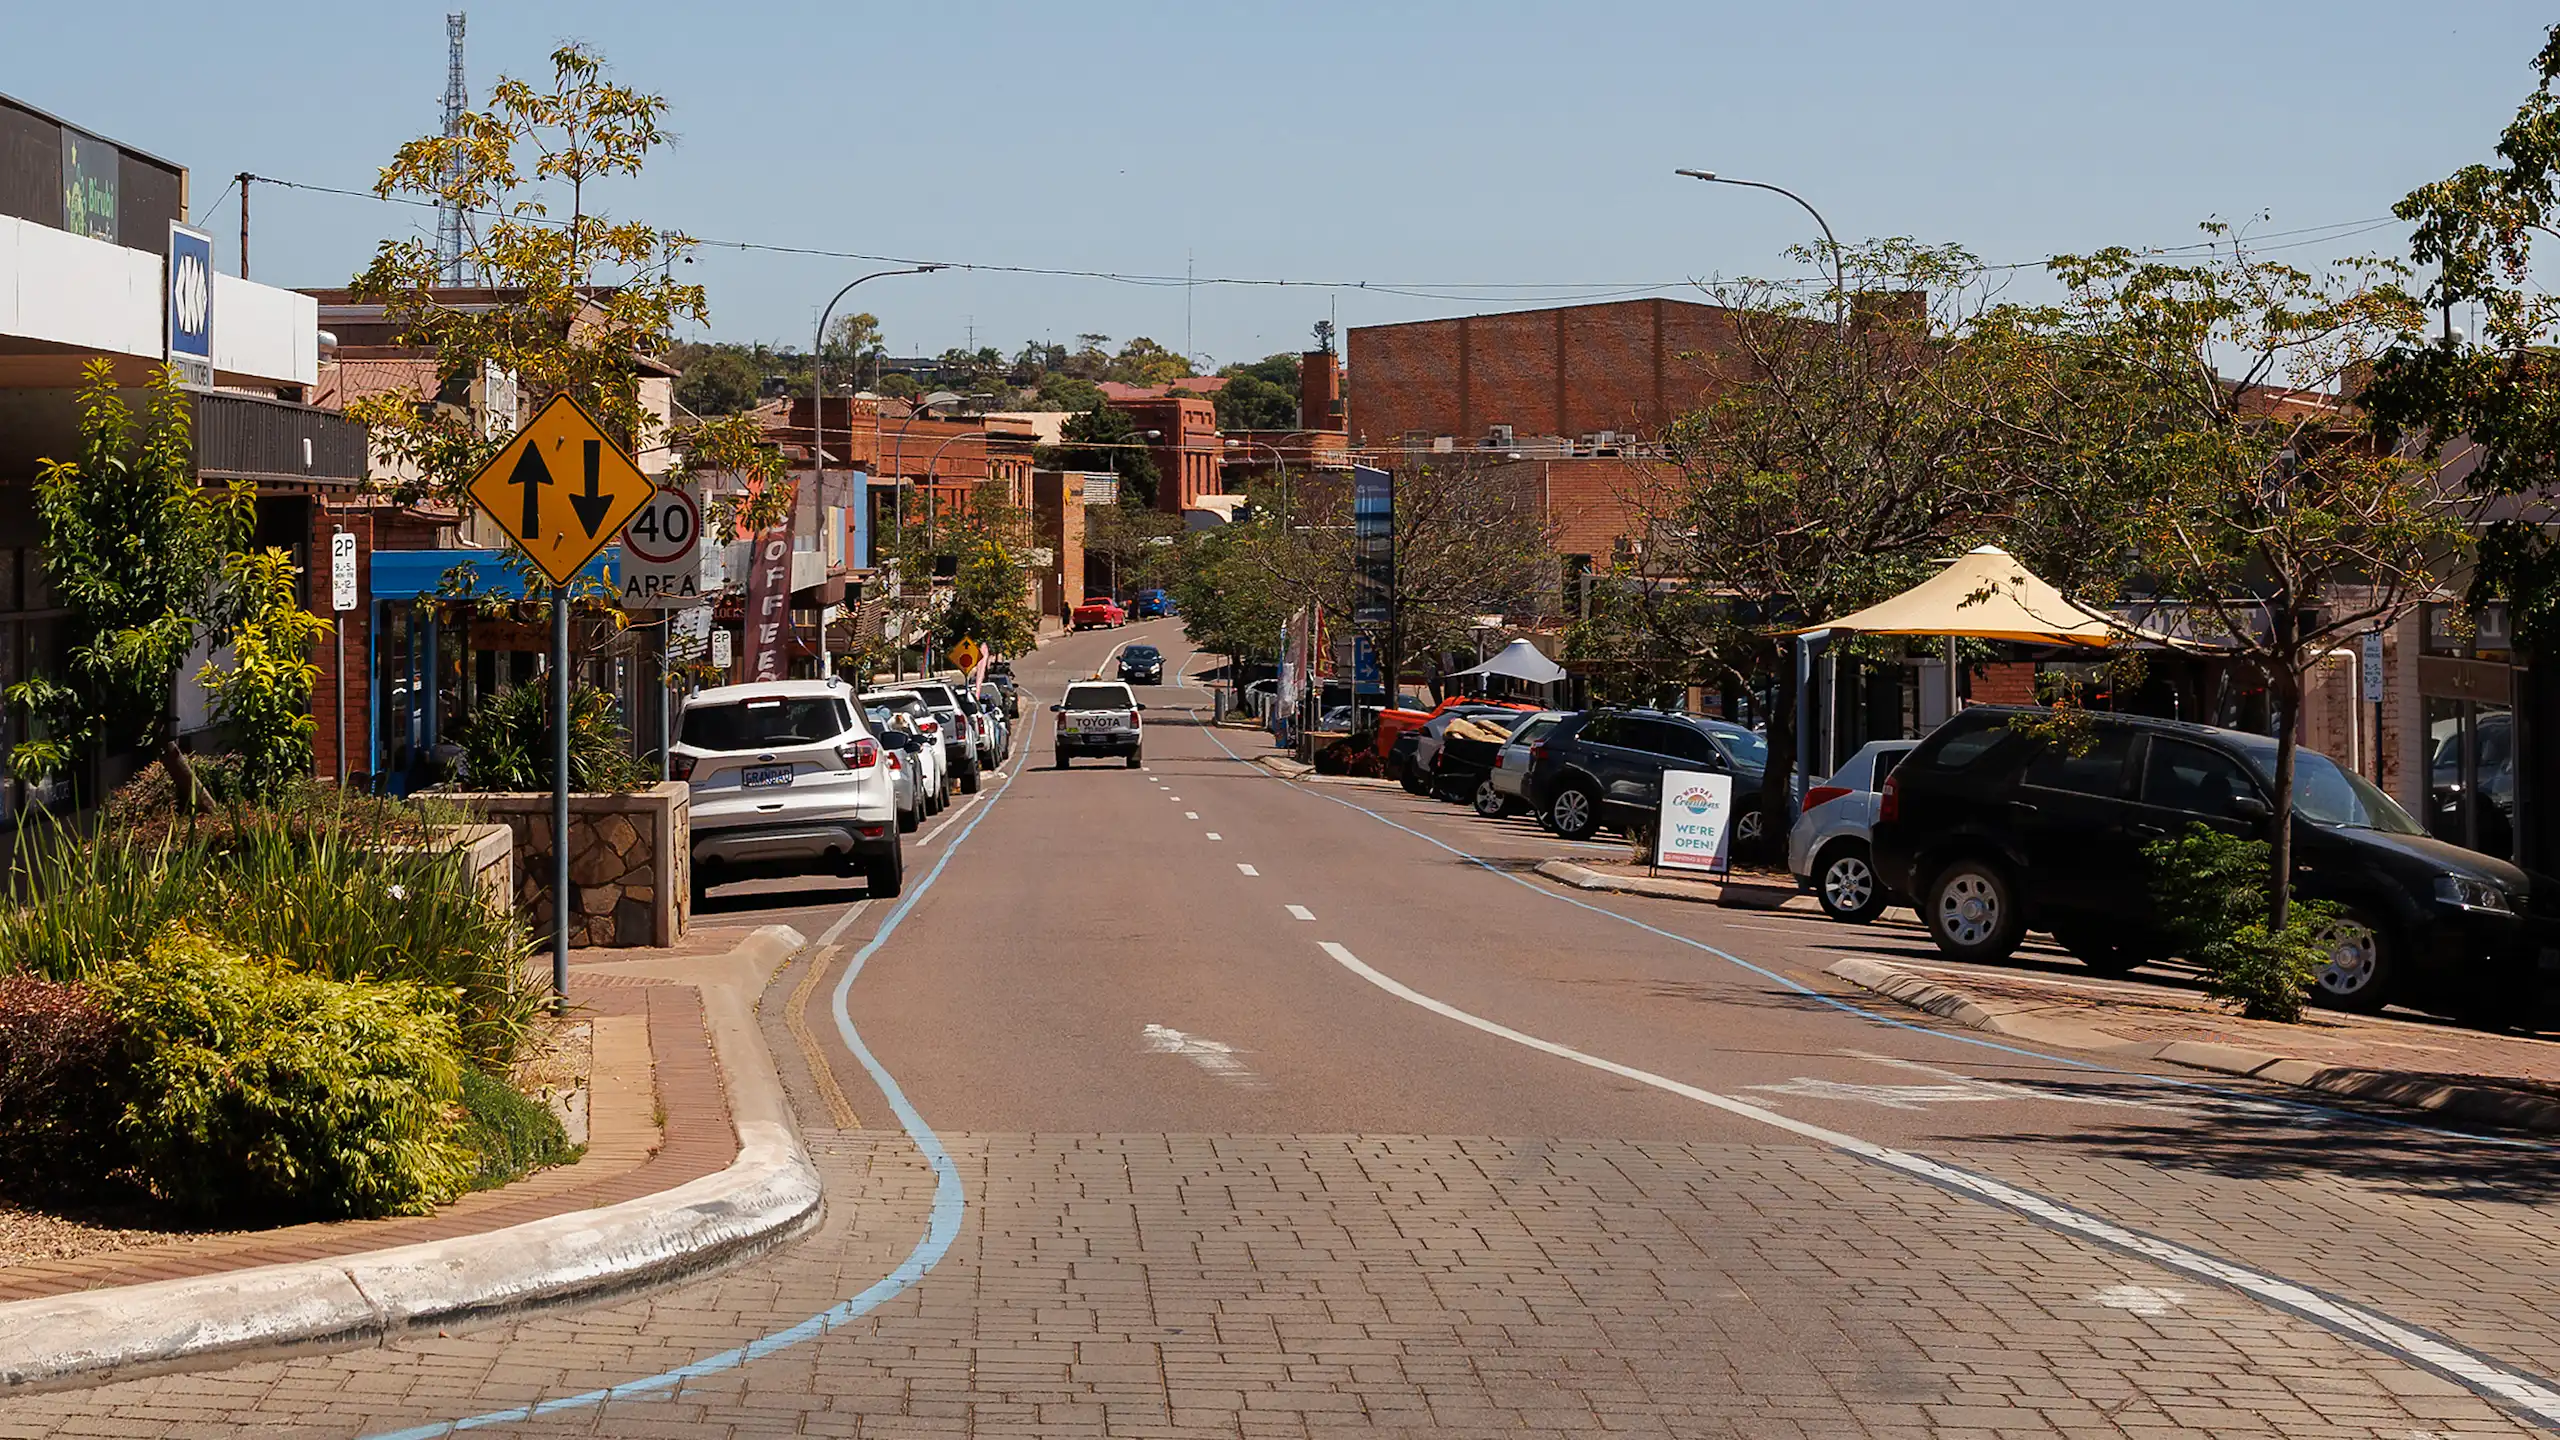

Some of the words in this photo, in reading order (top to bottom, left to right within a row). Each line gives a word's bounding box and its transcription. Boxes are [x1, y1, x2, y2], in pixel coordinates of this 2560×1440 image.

[632, 504, 689, 543] 40
[335, 539, 354, 557] 2P
[625, 575, 697, 598] AREA
[715, 633, 729, 643] 2P
[1360, 640, 1373, 661] P
[1076, 718, 1120, 727] TOYOTA
[1676, 823, 1715, 837] WE'RE
[1675, 838, 1714, 850] OPEN!
